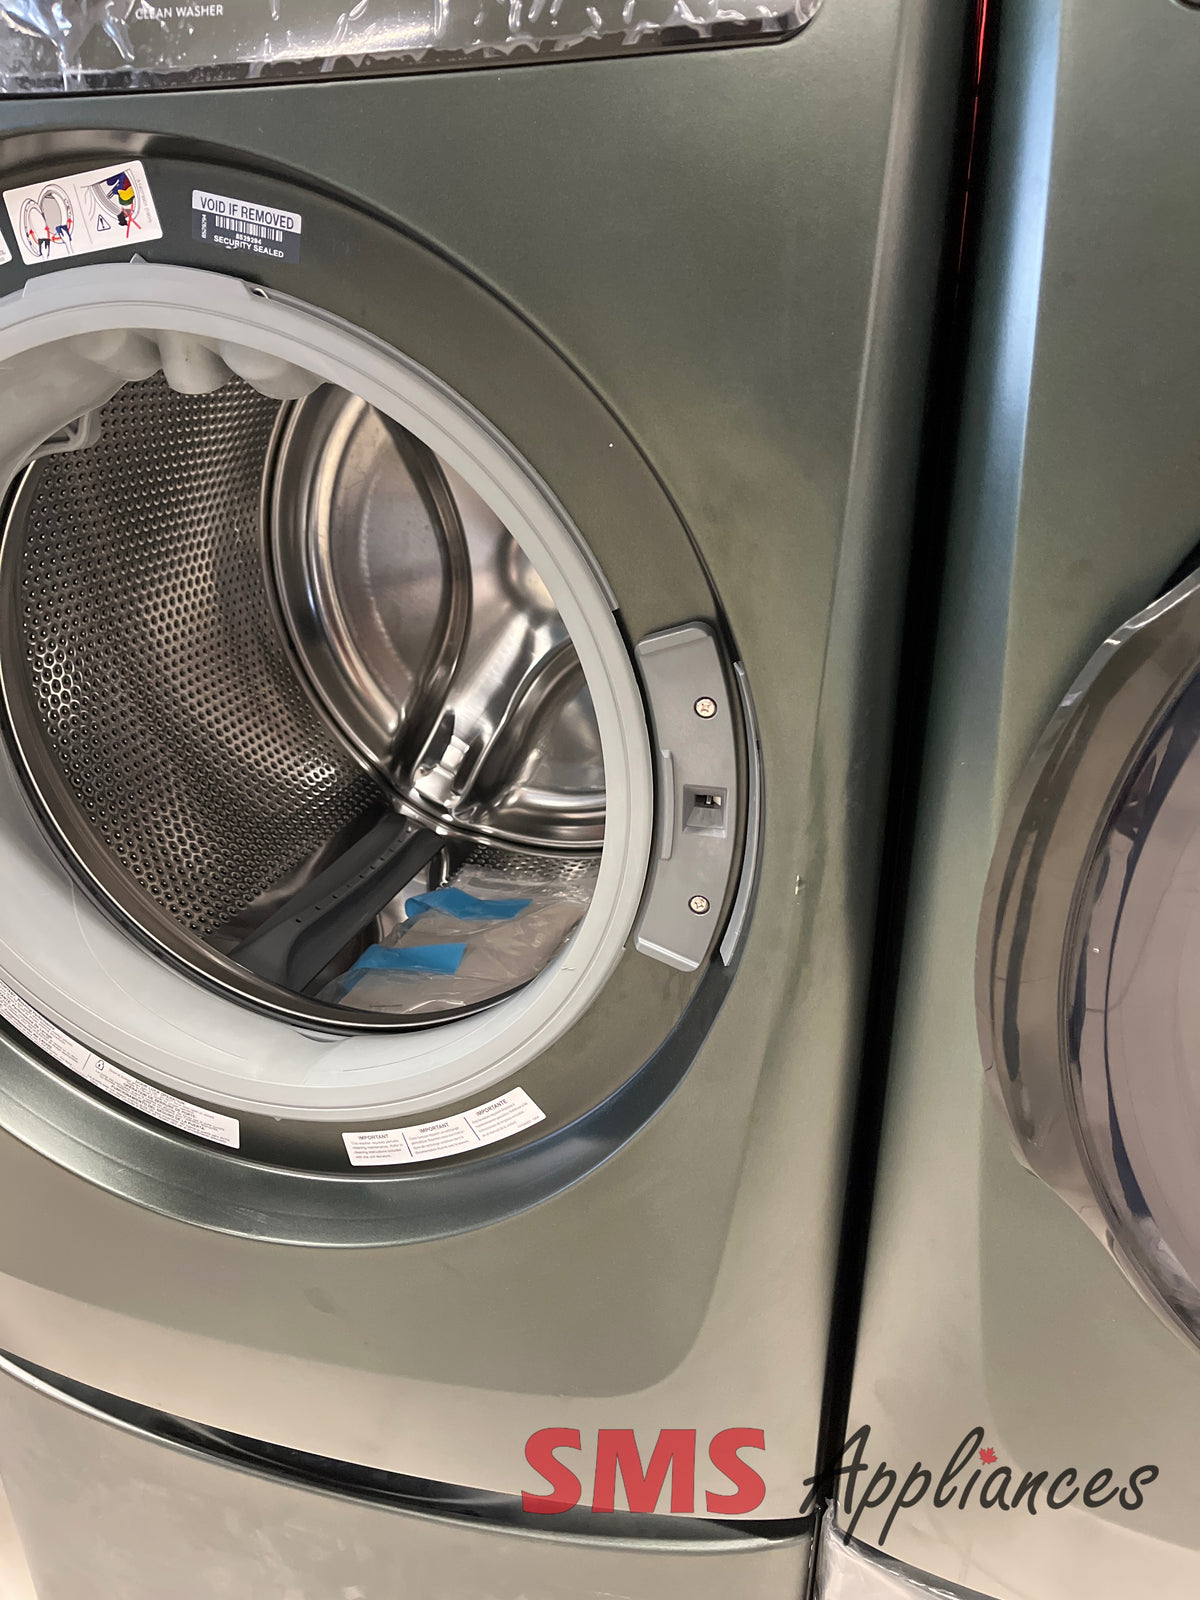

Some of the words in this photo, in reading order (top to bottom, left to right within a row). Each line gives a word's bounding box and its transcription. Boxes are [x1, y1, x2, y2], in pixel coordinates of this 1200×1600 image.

[135, 7, 172, 20] CLEAN
[175, 4, 224, 17] WASHER
[200, 196, 226, 214] VOID
[228, 202, 239, 216] IF
[241, 205, 295, 230] REMOVED
[213, 234, 252, 251] SECURITY
[253, 244, 285, 258] SEALED
[475, 1098, 508, 1116] IMPORTANTE
[419, 1122, 449, 1133] IMPORTANT
